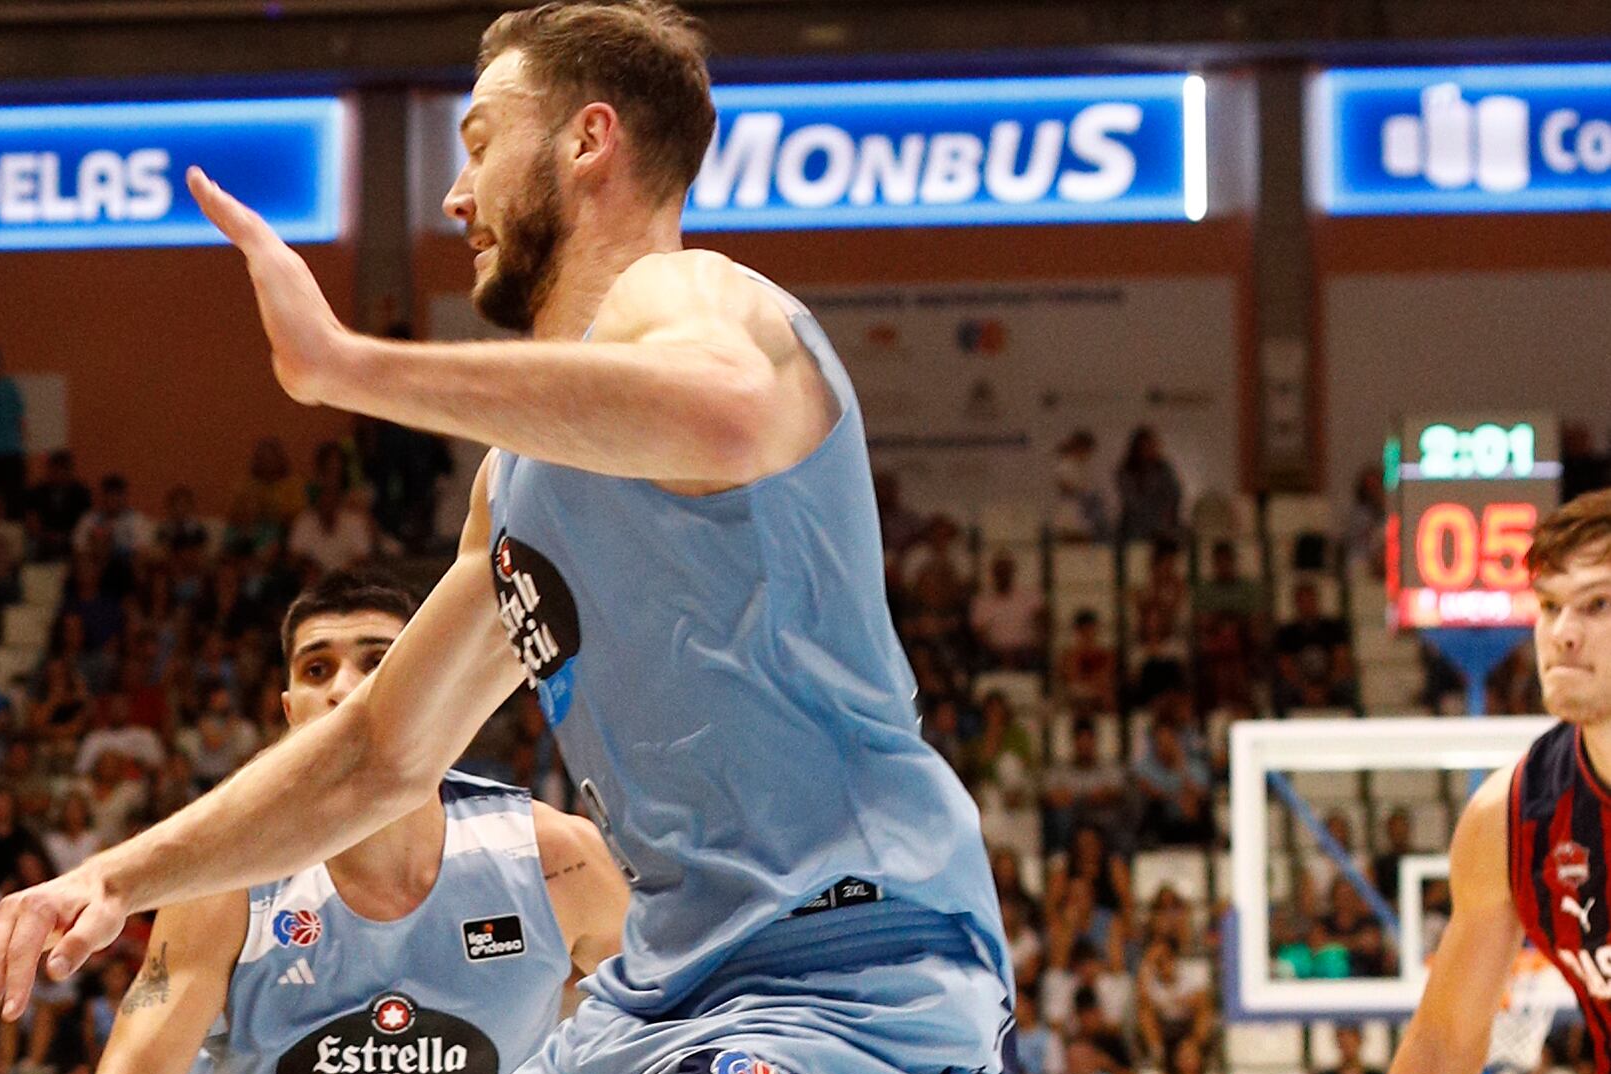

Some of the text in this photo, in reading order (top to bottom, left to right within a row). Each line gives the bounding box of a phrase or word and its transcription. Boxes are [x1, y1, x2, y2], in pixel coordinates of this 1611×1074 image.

[1418, 421, 1536, 479] 2:01
[1416, 502, 1537, 590] 05
[312, 1034, 468, 1074] Estrella
